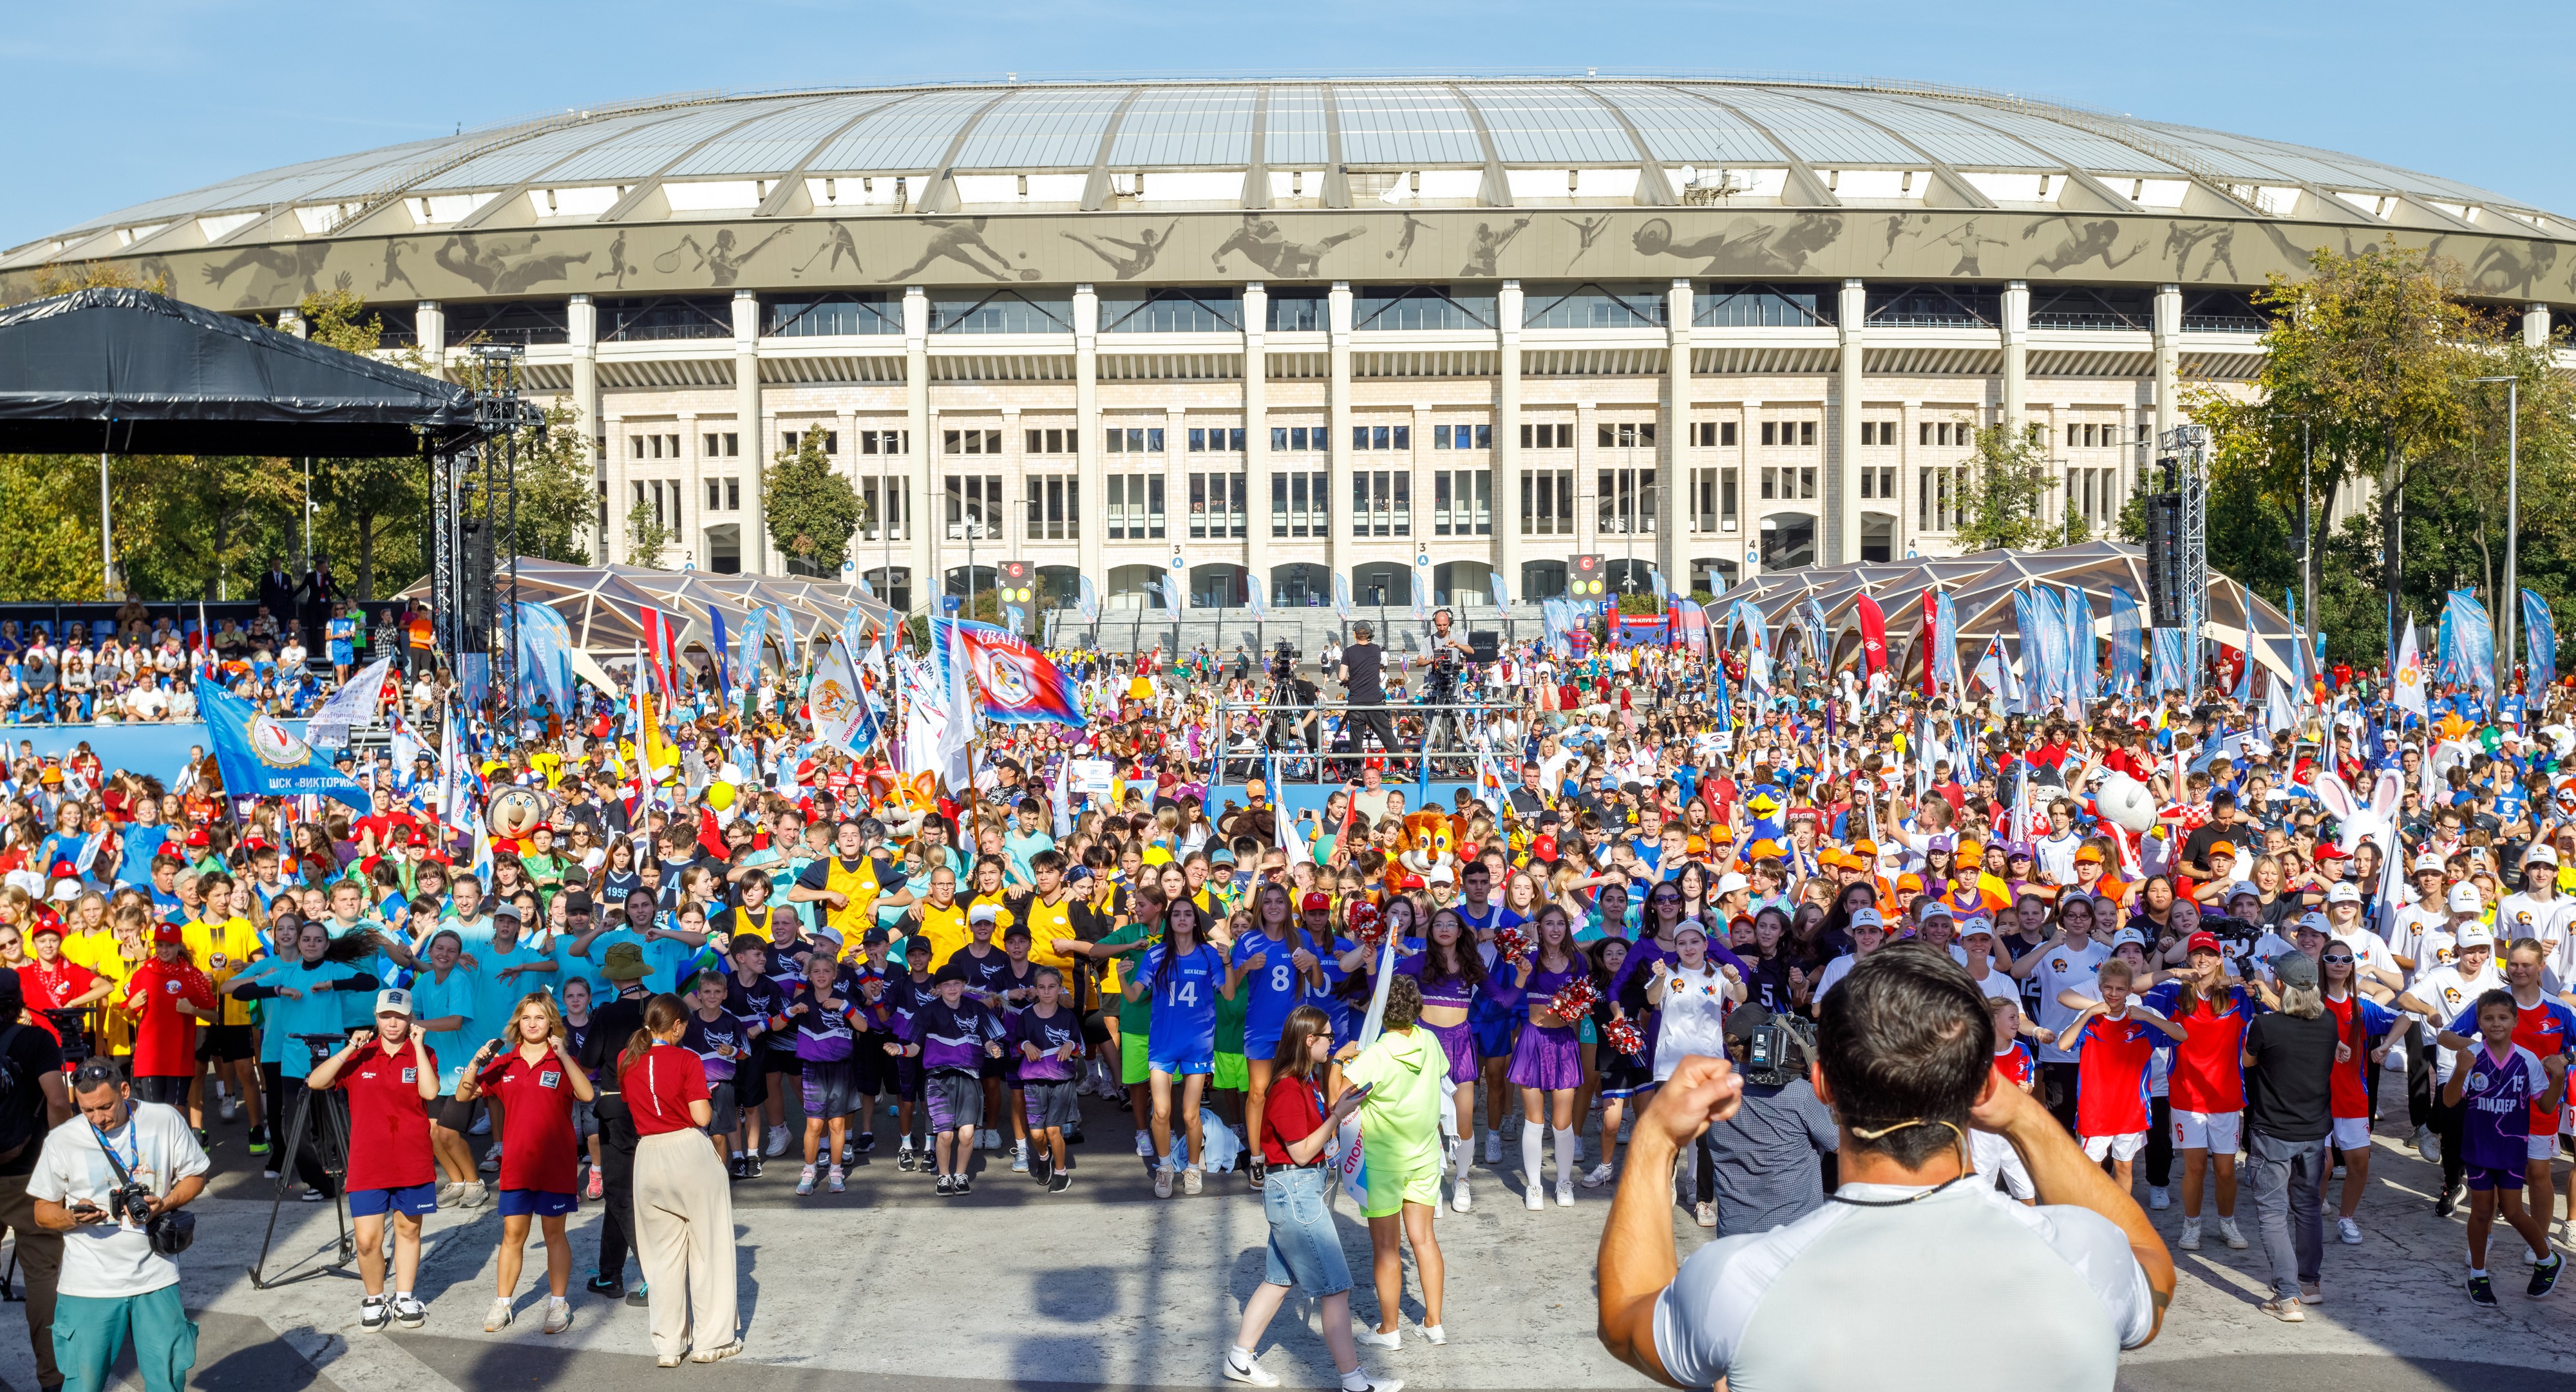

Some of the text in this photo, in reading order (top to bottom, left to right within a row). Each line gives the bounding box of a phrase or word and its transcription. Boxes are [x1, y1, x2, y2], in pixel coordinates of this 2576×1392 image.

[1174, 545, 1180, 554] 3
[1419, 543, 1426, 552] 3
[1748, 540, 1756, 549] 4
[1909, 539, 1916, 548] 4
[687, 551, 692, 560] 2
[844, 549, 851, 557] 2
[1012, 566, 1019, 574] C
[1584, 603, 1591, 612] A
[838, 682, 850, 695] КЛУБ
[1680, 695, 1690, 704] 88
[840, 701, 853, 719] ФОРВАРД
[2468, 707, 2481, 715] 1507
[841, 706, 866, 742] СПОРТИВНЫЙ
[858, 712, 881, 742] ФОРВД
[721, 736, 730, 749] 10
[269, 777, 356, 789] ШСК «ВИКТОРИЯ»
[1714, 793, 1721, 805] 2
[241, 804, 252, 813] 27
[607, 886, 629, 898] 1955
[1271, 965, 1290, 992] 8
[622, 986, 639, 995] SONY
[1304, 972, 1331, 998] 10
[2021, 975, 2041, 997] 12
[1168, 981, 1198, 1007] 14
[1761, 984, 1773, 1007] 5
[2512, 1075, 2524, 1093] 15
[653, 1100, 662, 1116] СПОРТОМ
[2477, 1096, 2517, 1115] ЛИДЕР
[2568, 1109, 2575, 1129] 9
